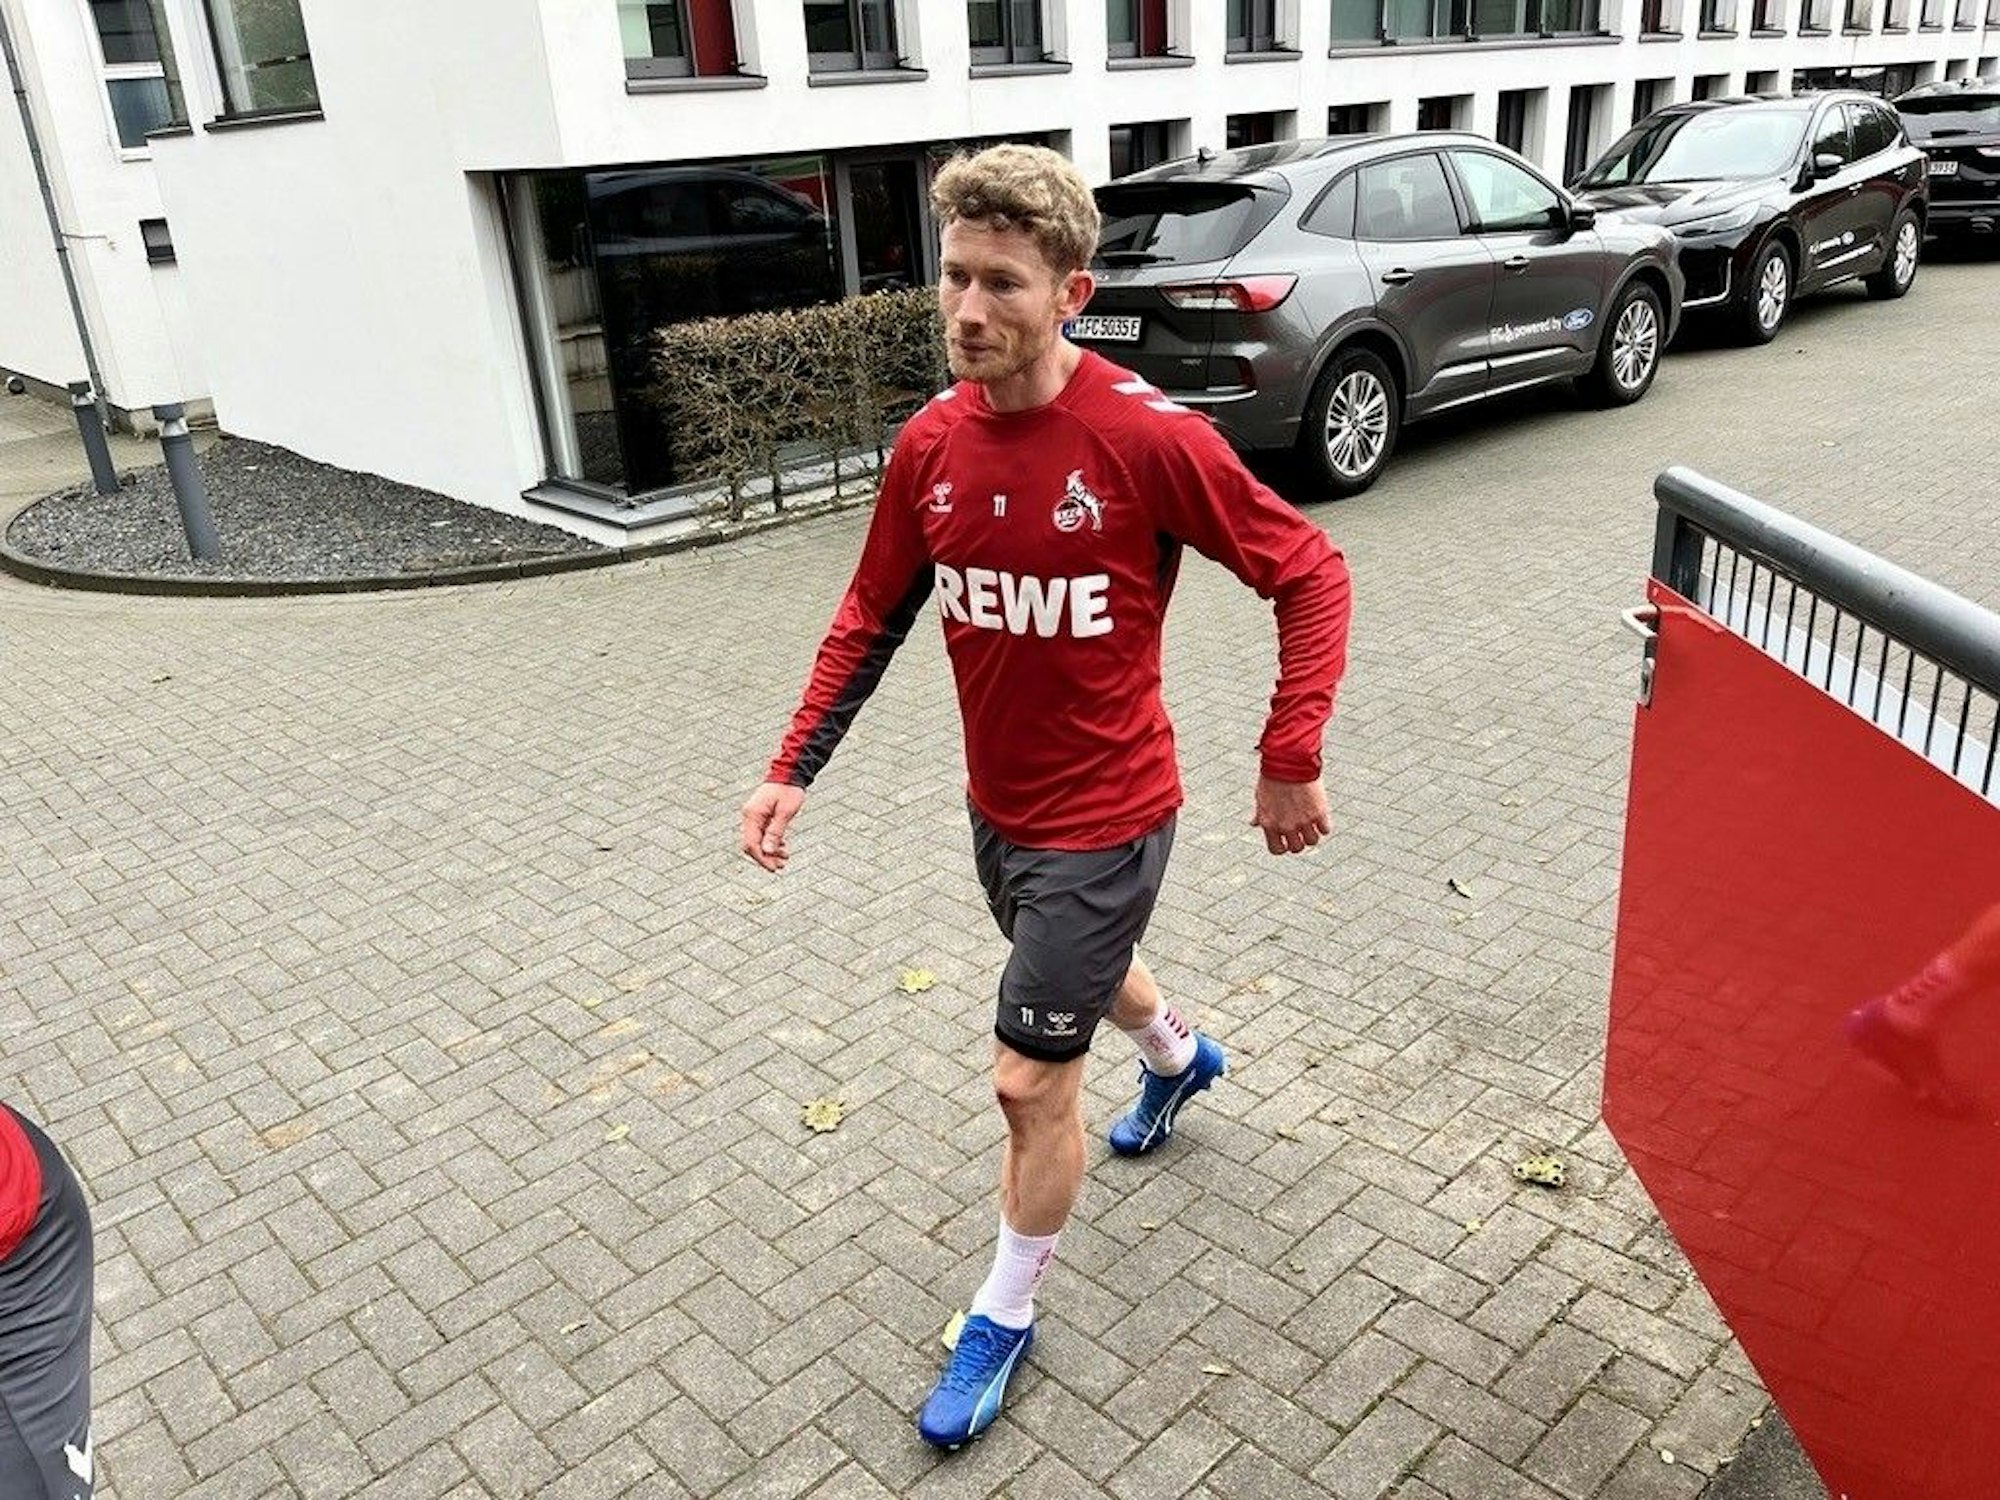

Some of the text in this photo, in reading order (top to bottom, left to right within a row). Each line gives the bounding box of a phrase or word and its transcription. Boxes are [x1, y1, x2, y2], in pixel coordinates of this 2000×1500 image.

[1513, 318, 1551, 339] powered
[992, 494, 1007, 517] 11
[935, 562, 1114, 638] REWE
[1020, 1006, 1034, 1027] 11
